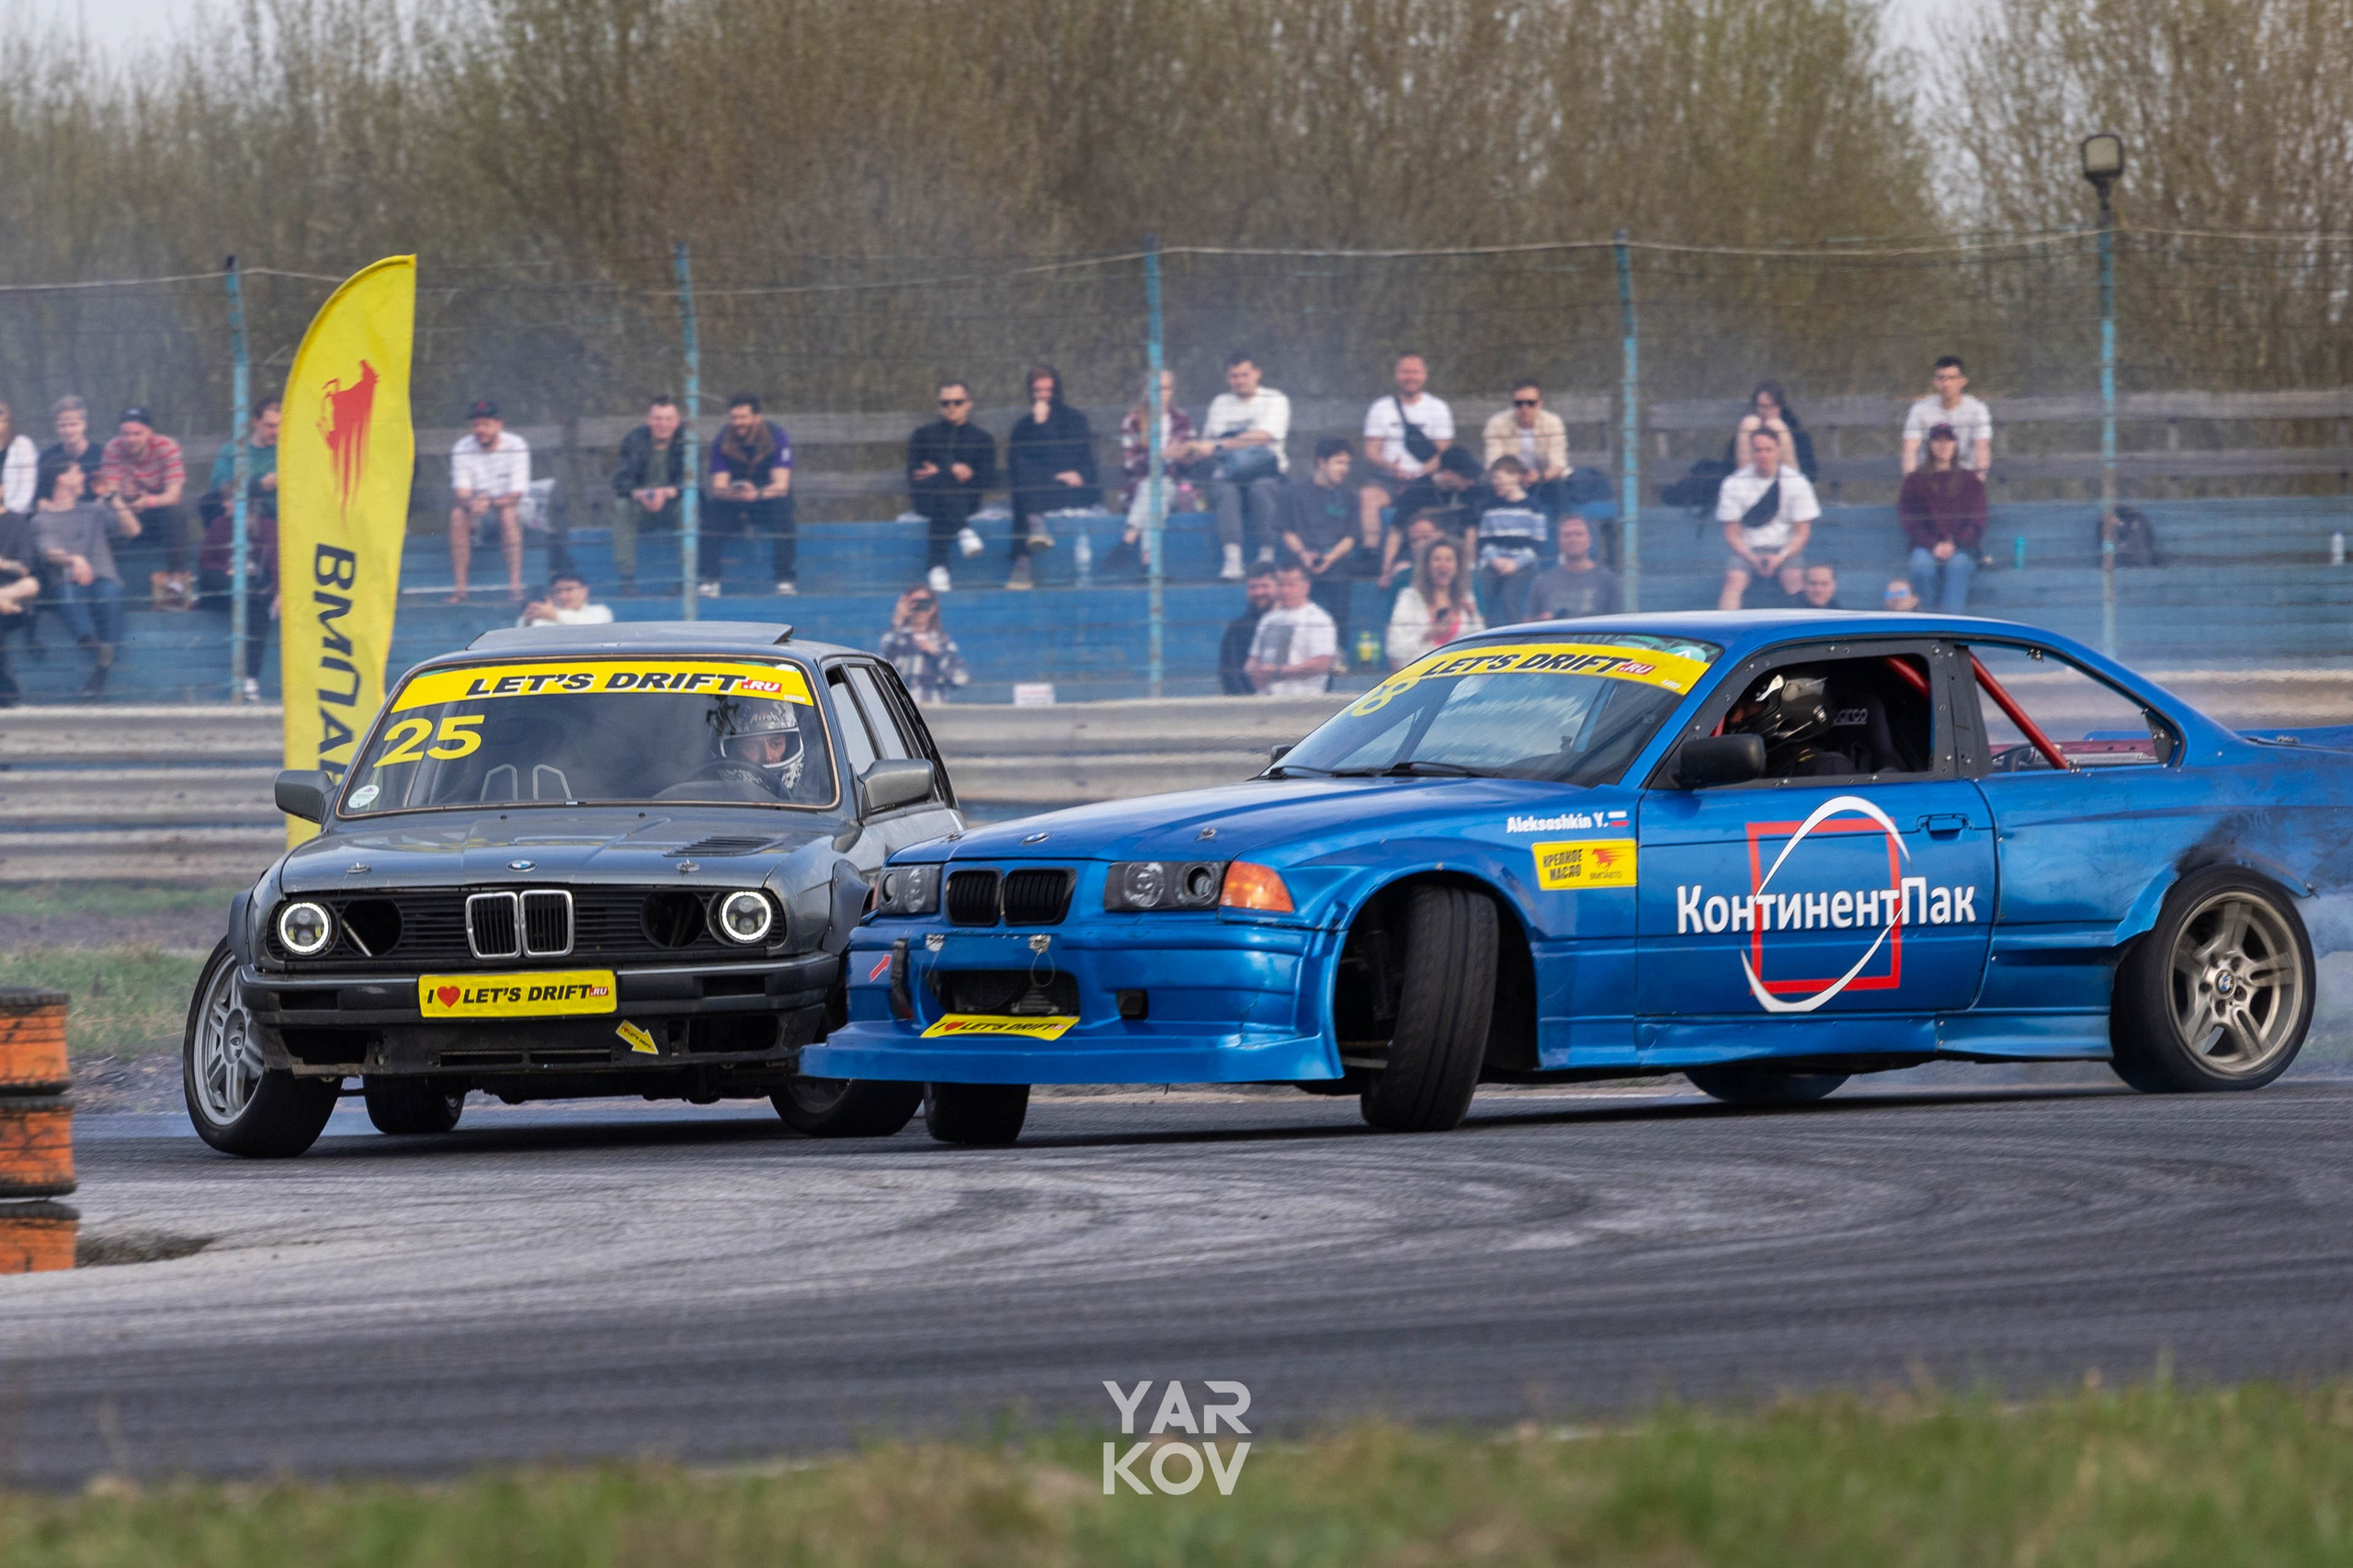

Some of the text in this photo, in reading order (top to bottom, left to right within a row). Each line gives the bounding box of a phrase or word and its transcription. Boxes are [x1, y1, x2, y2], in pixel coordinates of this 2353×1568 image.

[1420, 653, 1522, 677] LET'S
[465, 673, 595, 698] LET'S
[372, 714, 485, 768] 25
[426, 989, 435, 1004] I
[462, 986, 522, 1004] LET'S
